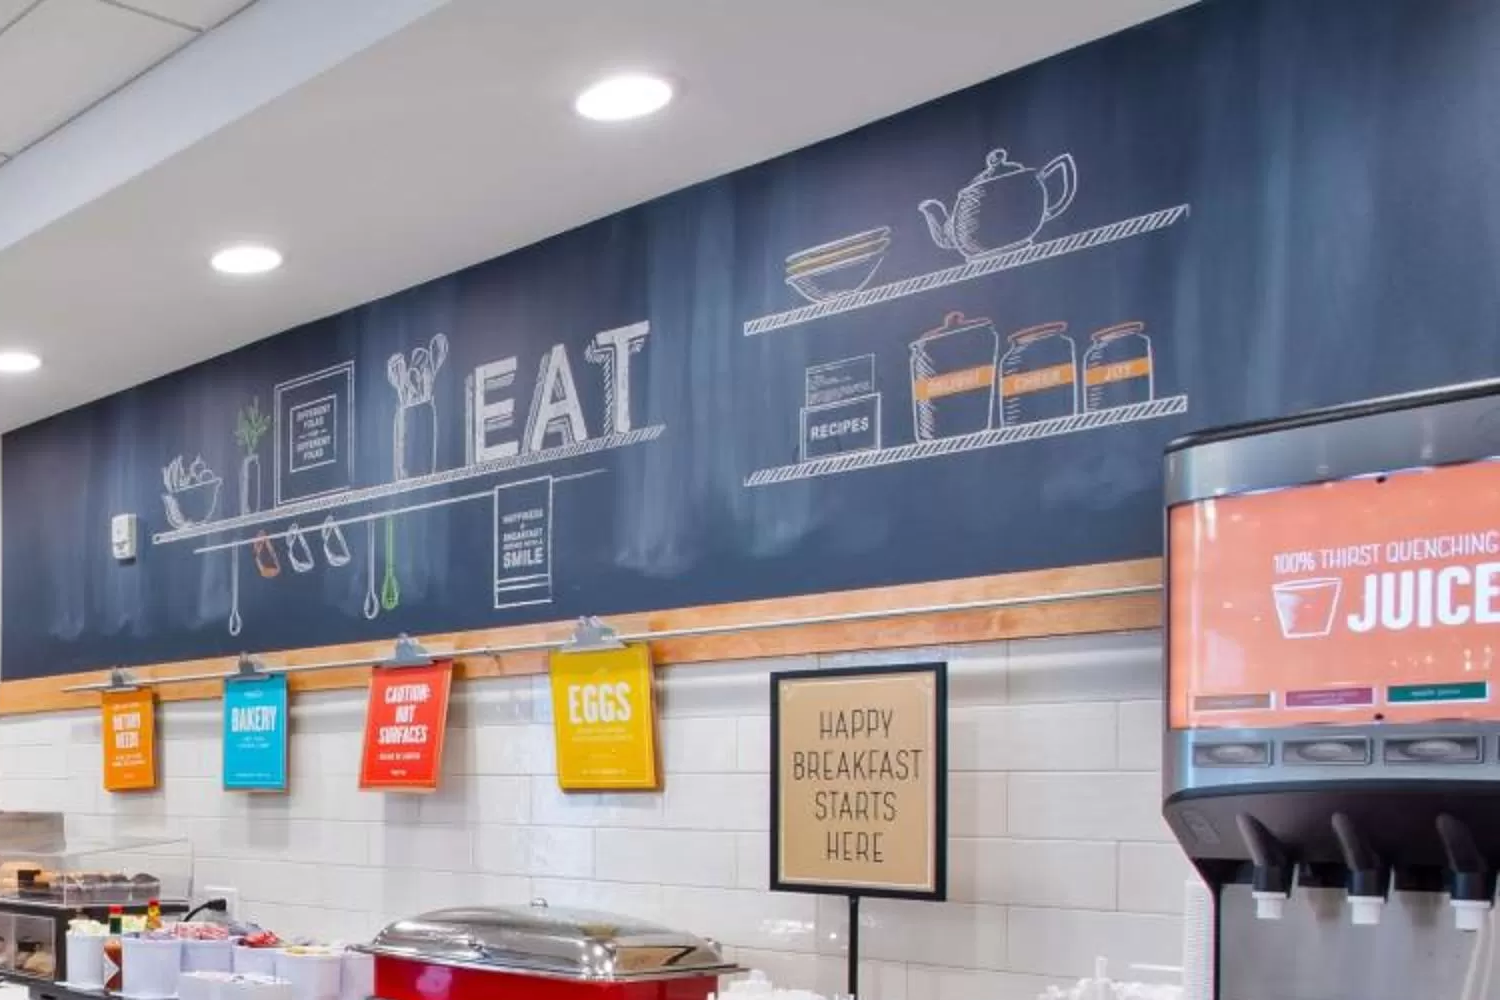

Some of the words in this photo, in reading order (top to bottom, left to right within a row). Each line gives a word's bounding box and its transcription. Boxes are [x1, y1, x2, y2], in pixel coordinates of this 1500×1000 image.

[465, 320, 650, 467] EAT
[811, 416, 869, 441] RECIPES
[503, 547, 544, 569] SMILE
[1273, 552, 1316, 573] 100%
[1321, 543, 1381, 569] THIRST
[1386, 530, 1500, 563] QUENCHING
[1347, 562, 1500, 632] JUICE
[231, 705, 278, 732] BAKERY
[395, 704, 416, 724] HOT
[568, 682, 632, 725] EGGS
[378, 724, 429, 745] SURFACES
[819, 709, 893, 740] HAPPY
[792, 749, 924, 781] BREAKFAST
[815, 791, 898, 822] STARTS
[827, 831, 884, 863] HERE
